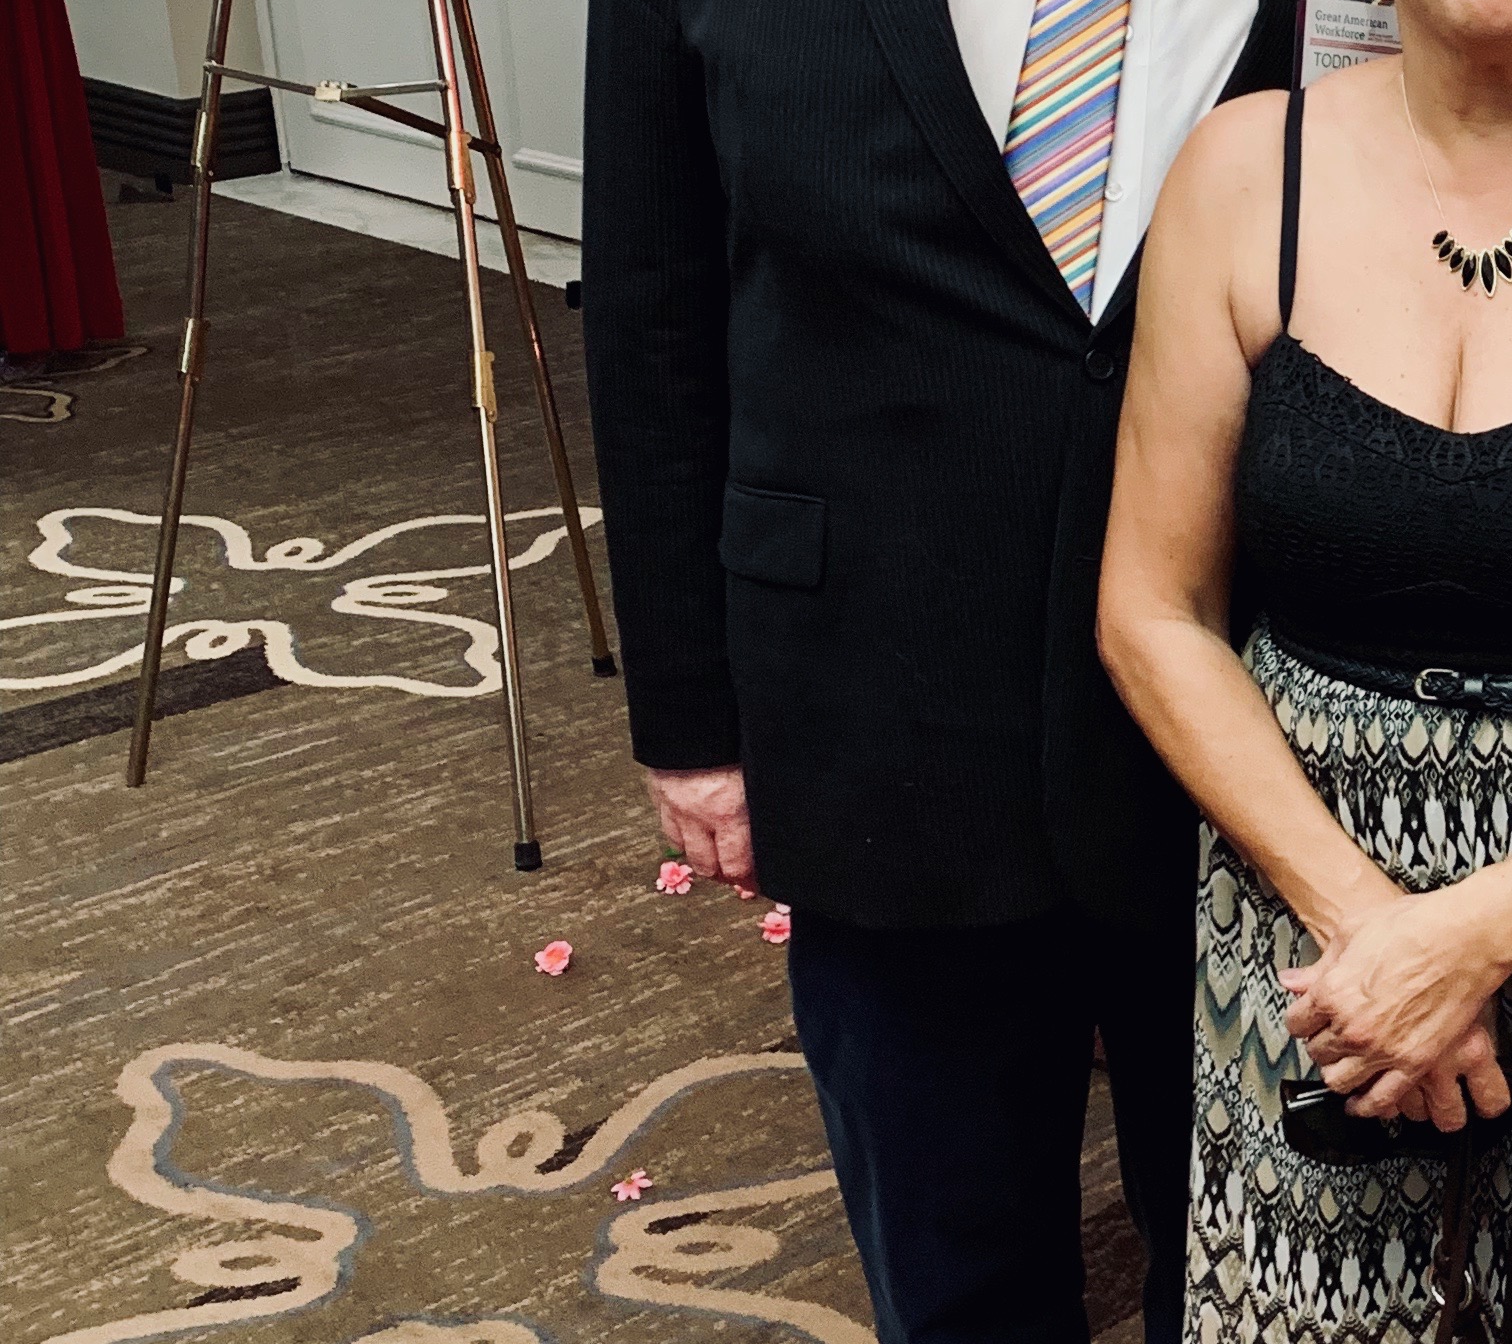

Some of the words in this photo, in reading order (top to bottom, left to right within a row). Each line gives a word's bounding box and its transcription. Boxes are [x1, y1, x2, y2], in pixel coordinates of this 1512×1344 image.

[1315, 9, 1341, 25] Great
[1343, 13, 1388, 30] American
[1314, 23, 1366, 41] Workforce
[1313, 51, 1352, 69] TODD
